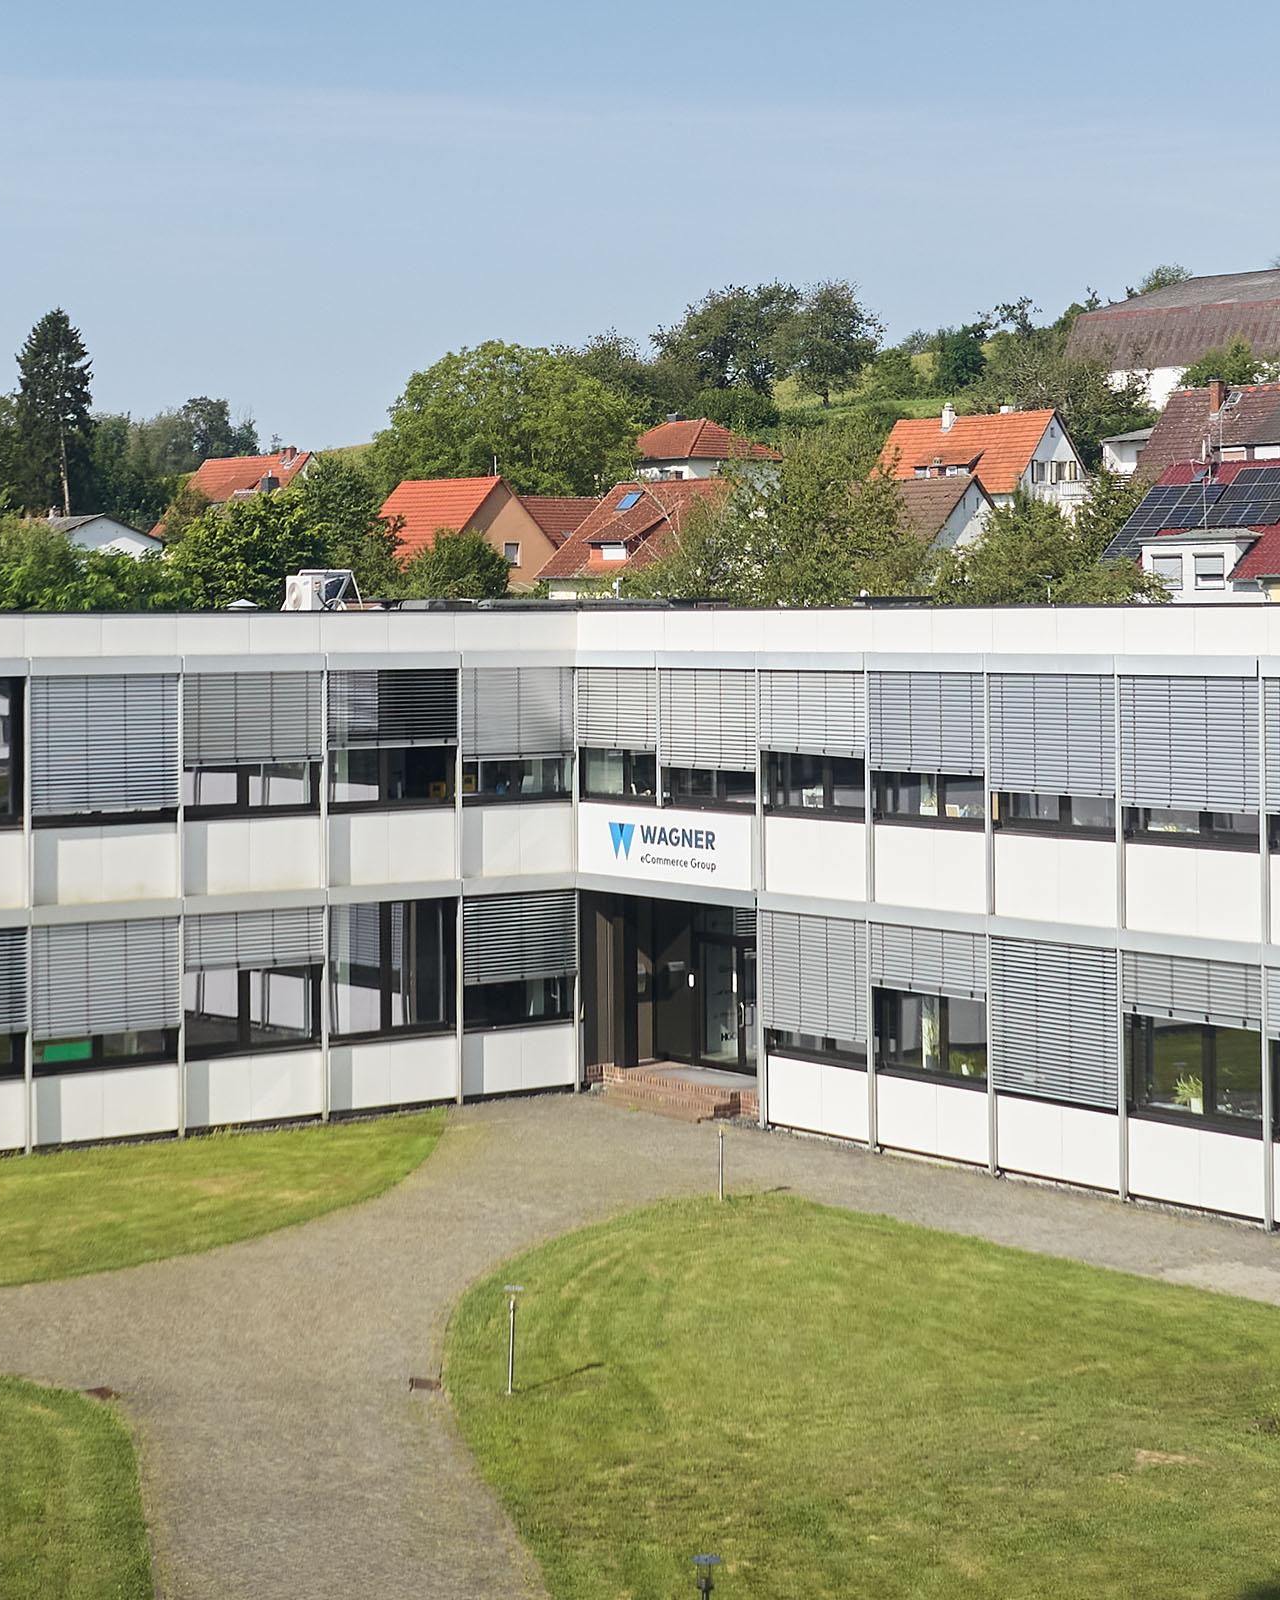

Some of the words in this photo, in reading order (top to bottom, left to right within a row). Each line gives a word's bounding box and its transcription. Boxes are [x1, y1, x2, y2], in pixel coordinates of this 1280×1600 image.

[640, 824, 716, 851] WAGNER
[640, 853, 689, 868] eCommerce
[690, 858, 717, 873] Group
